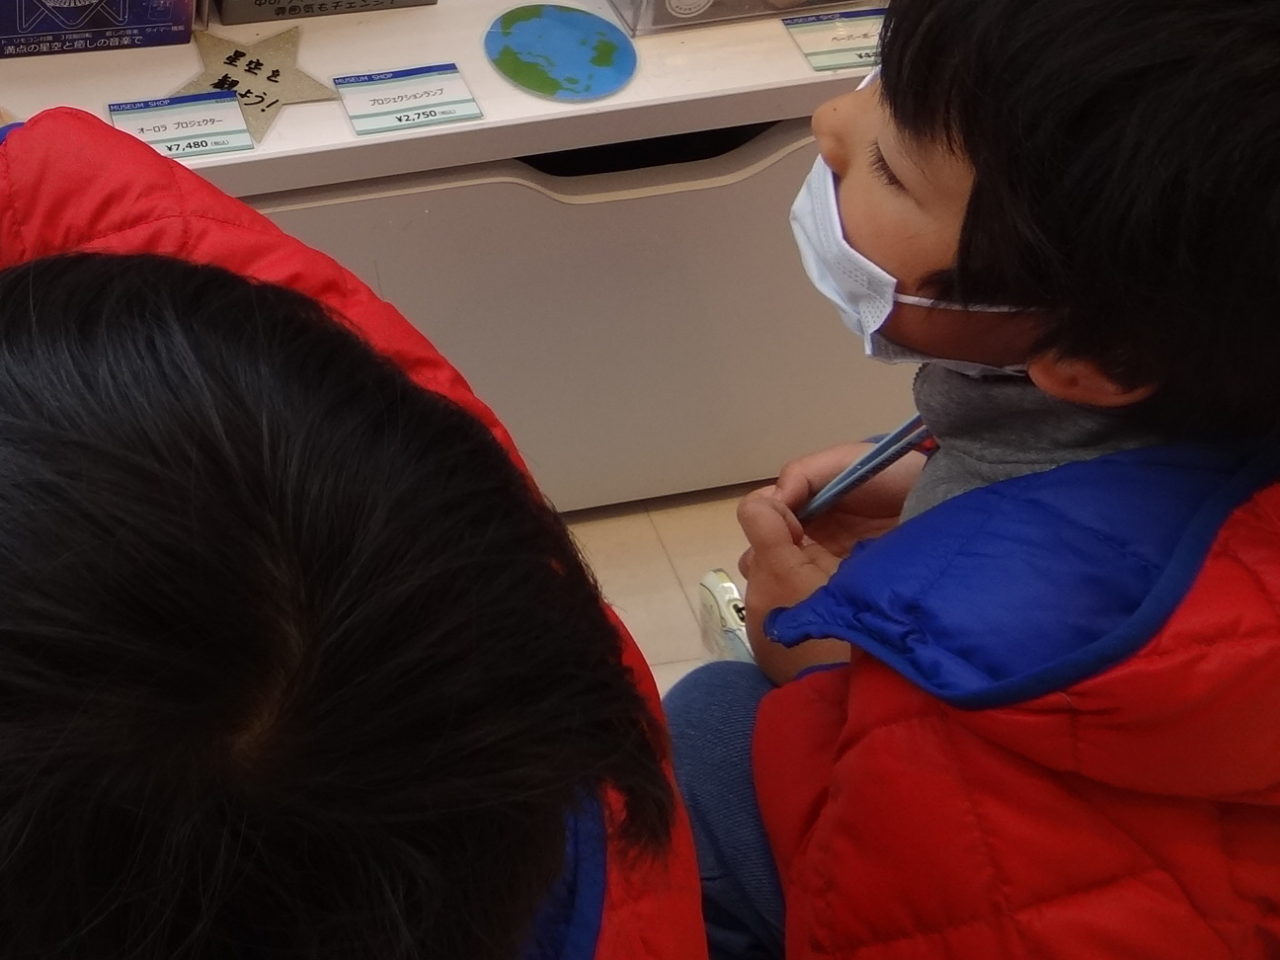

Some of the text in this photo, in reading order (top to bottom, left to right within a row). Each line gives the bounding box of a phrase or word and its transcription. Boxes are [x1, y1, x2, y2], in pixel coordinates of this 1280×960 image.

[223, 49, 280, 83] 星空を
[335, 73, 393, 85] MUSEUM SHOP
[370, 88, 444, 107] プロジェクションランプ
[110, 99, 170, 111] MUSEUM SHOP
[395, 110, 437, 122] ¥2,750
[137, 118, 223, 134] オーロラ プロジェクター
[166, 140, 208, 152] ¥7,480
